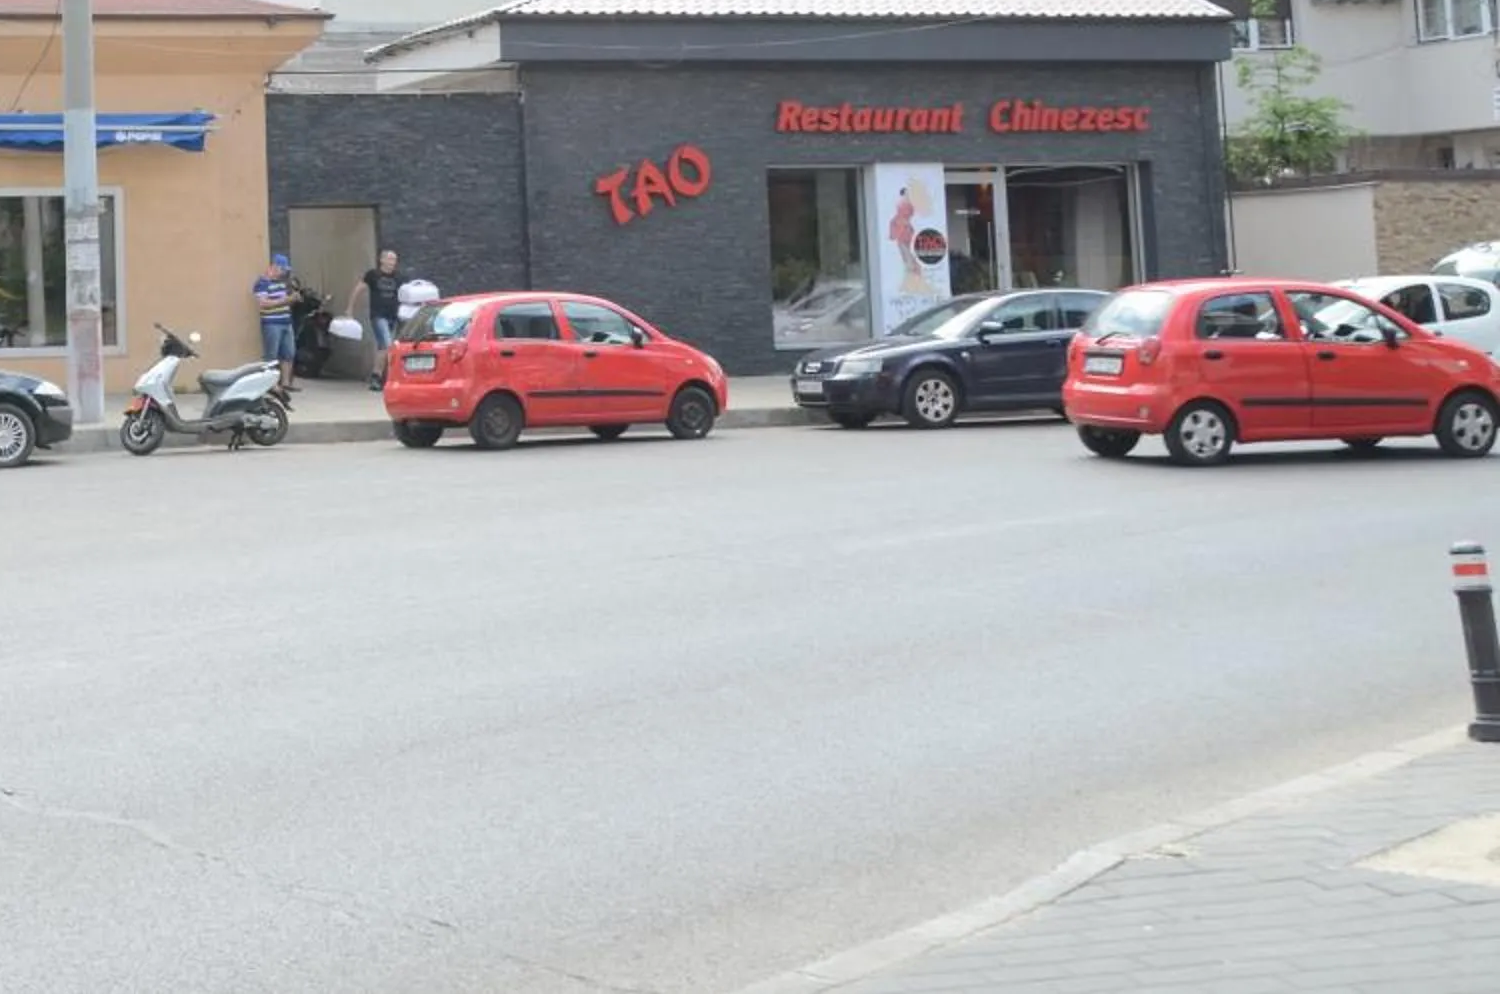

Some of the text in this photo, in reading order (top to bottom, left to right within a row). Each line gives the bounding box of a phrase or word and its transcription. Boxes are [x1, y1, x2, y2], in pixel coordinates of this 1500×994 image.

[778, 98, 1151, 133] Restaurant Chinezesc
[596, 144, 711, 224] TAO
